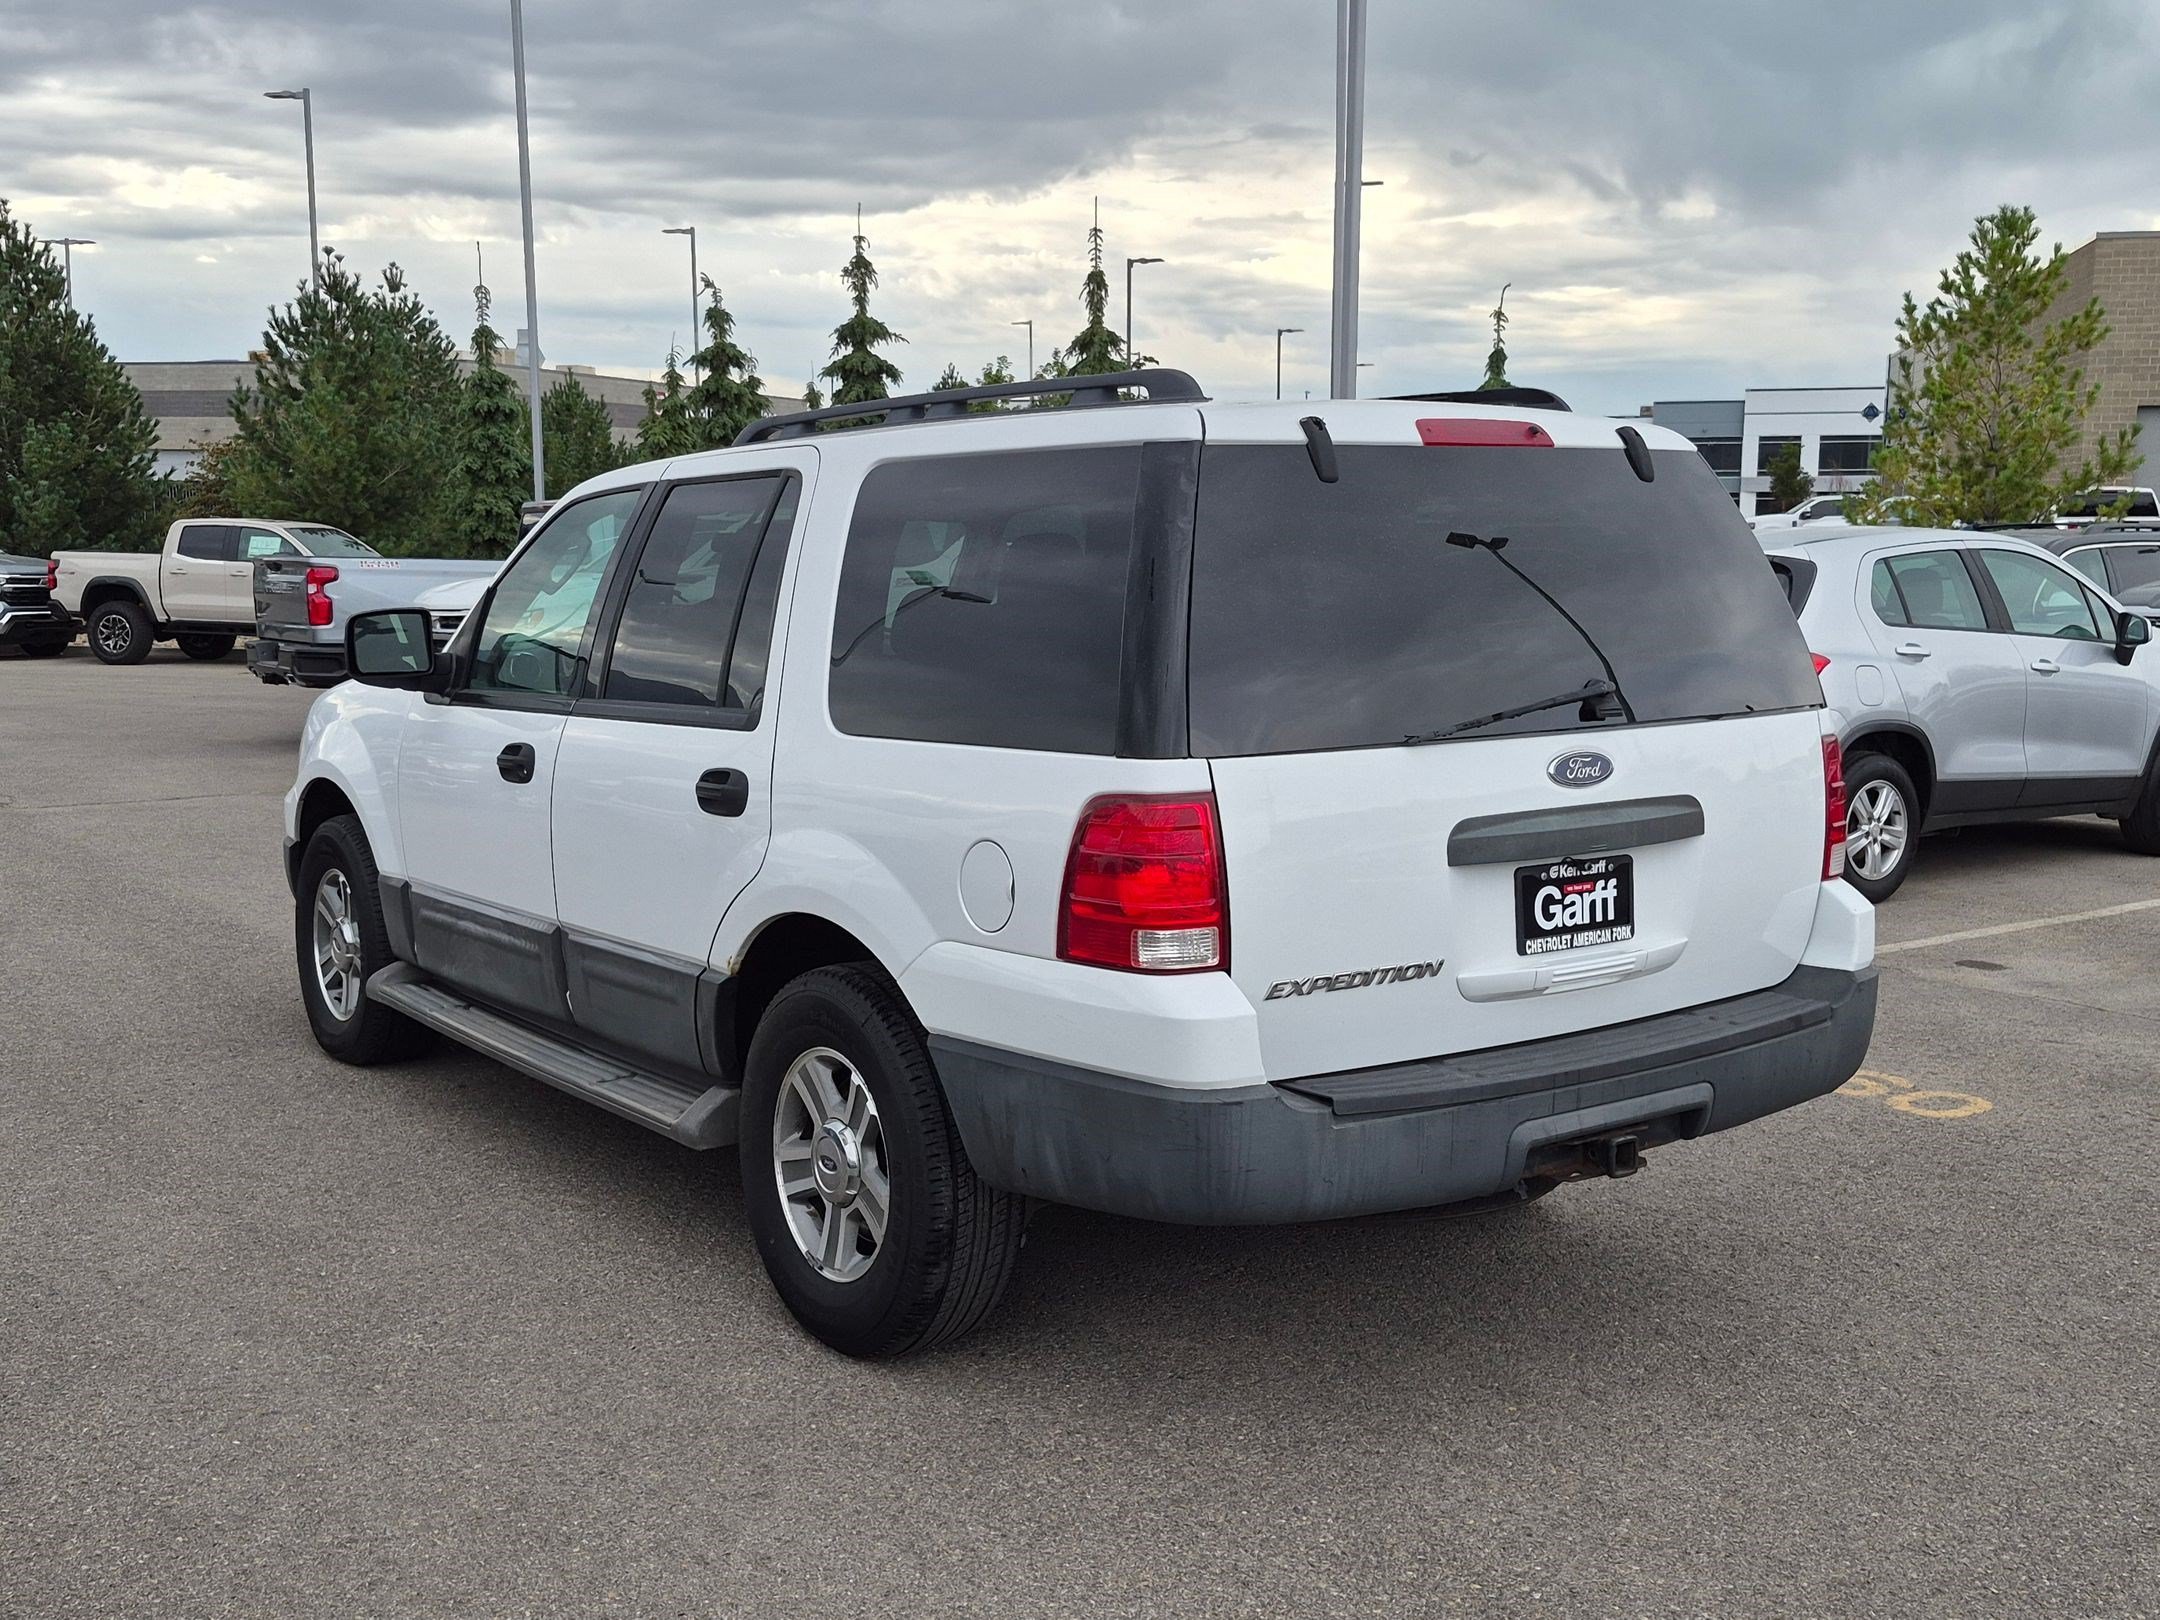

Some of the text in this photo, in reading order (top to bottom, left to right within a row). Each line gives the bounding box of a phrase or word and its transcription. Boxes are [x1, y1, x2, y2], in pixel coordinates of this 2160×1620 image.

[1566, 756, 1602, 779] Ford
[1534, 878, 1618, 930] Garff
[1525, 925, 1632, 954] CHEVROLET AMERICAN FORK
[1263, 958, 1445, 1001] EXPEDITION
